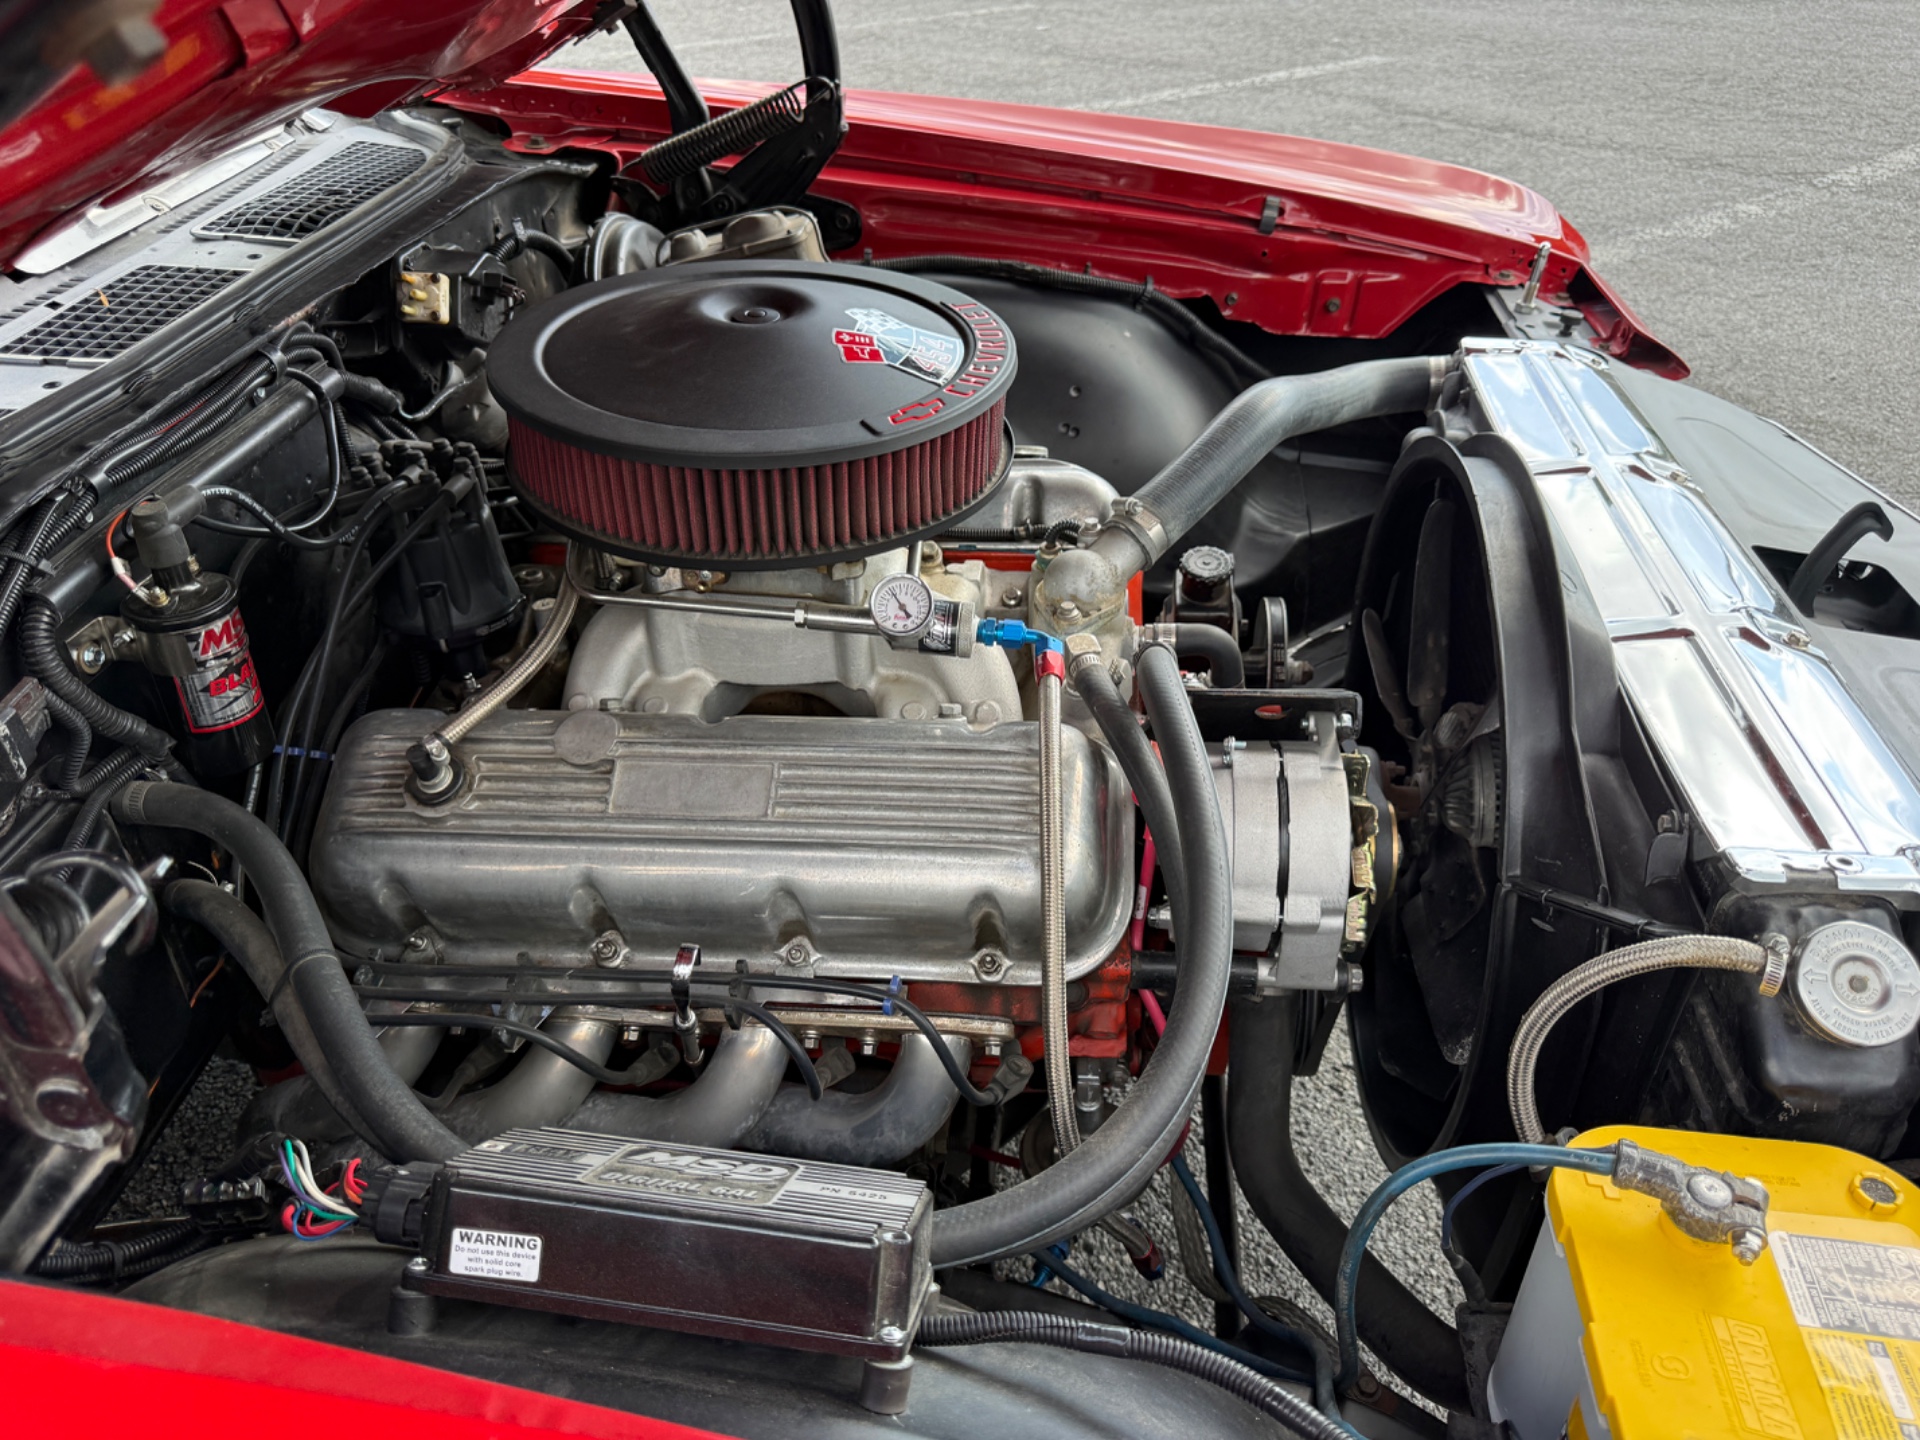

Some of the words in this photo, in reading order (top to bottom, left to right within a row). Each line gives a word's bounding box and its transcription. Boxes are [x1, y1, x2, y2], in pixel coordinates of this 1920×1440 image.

[913, 335, 954, 371] 454
[943, 303, 1007, 398] CHEVROLET
[620, 1150, 790, 1180] MSD
[600, 1171, 702, 1194] DIGITAL
[459, 1230, 538, 1250] WARNING
[455, 1244, 465, 1252] Do
[496, 1249, 510, 1257] this
[512, 1251, 536, 1260] device
[485, 1258, 503, 1266] solid
[464, 1265, 484, 1273] spark
[486, 1267, 503, 1276] plug
[1731, 1321, 1797, 1436] OPTIMA
